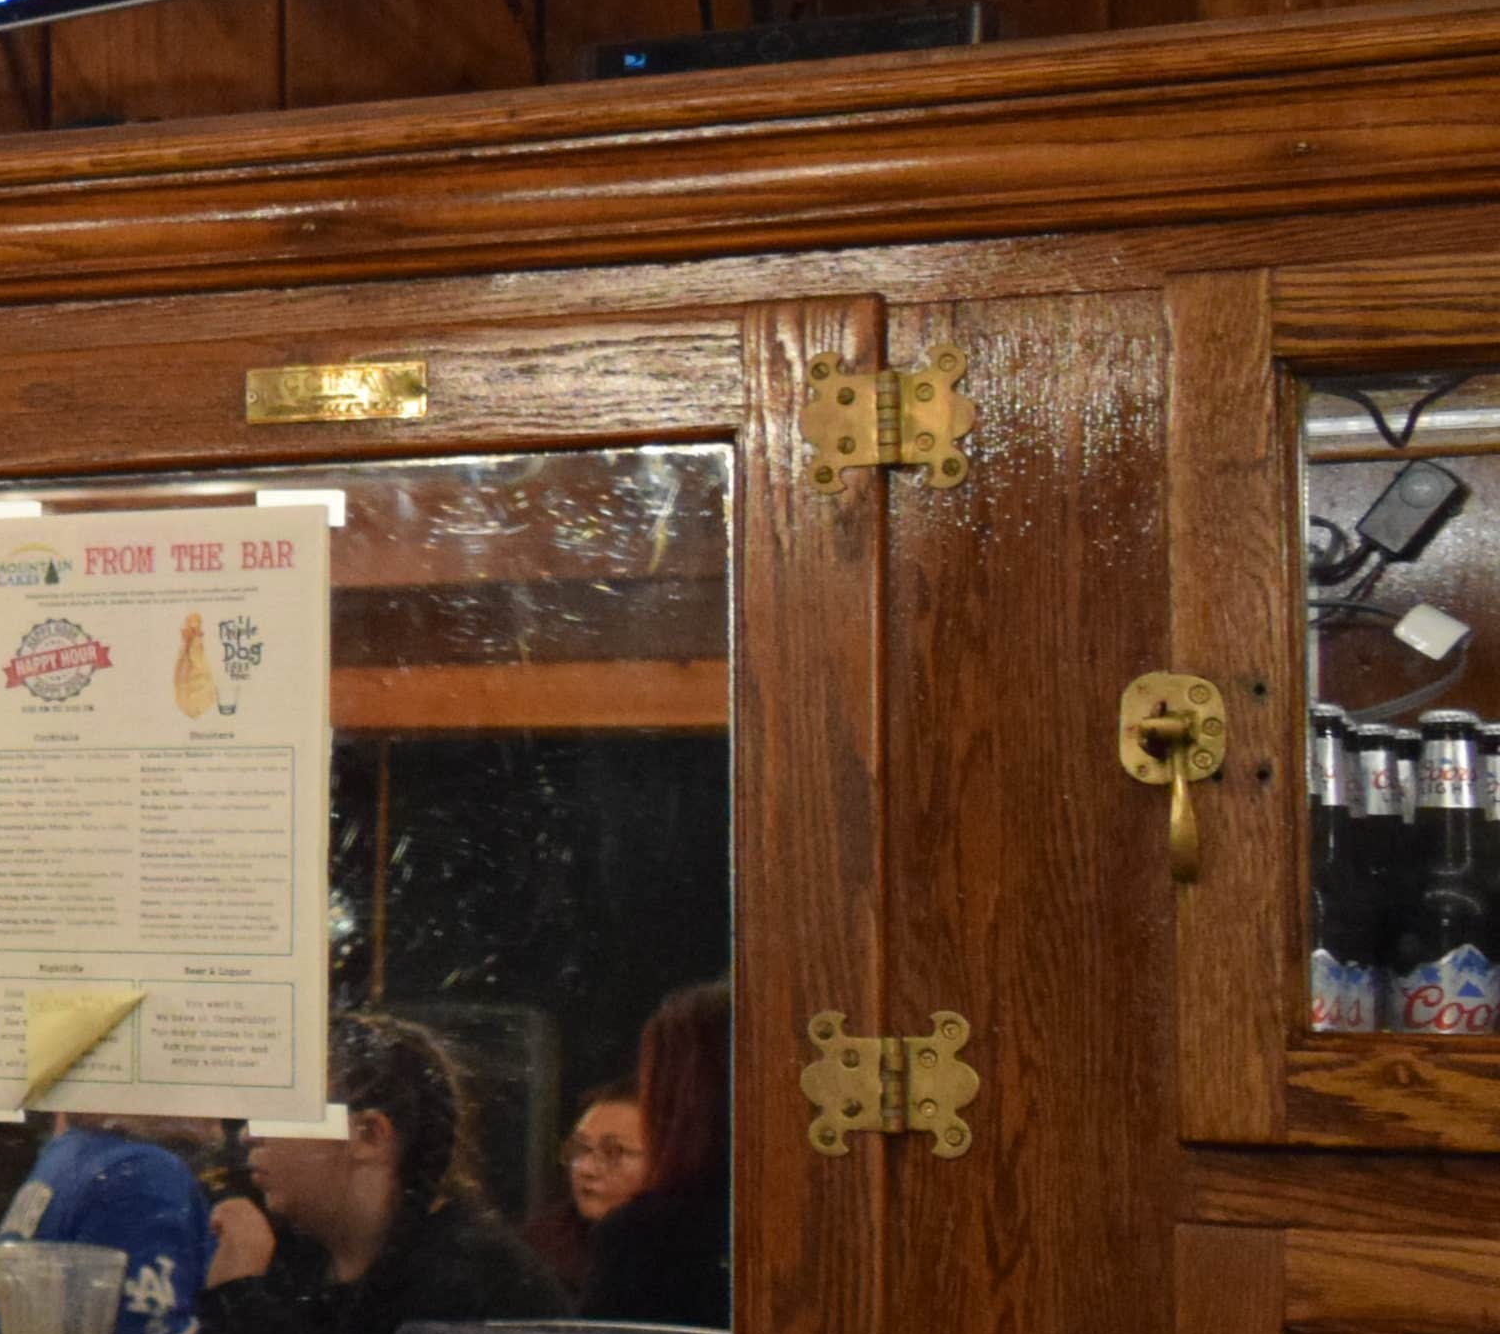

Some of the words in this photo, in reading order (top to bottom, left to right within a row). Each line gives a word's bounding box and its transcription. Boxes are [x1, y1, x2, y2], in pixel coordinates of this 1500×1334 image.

[83, 545, 157, 576] FROM
[170, 542, 224, 573] THE
[240, 539, 296, 571] BAR
[14, 651, 58, 676] HAPPY
[60, 643, 98, 669] HOUR
[223, 642, 264, 665] Dog
